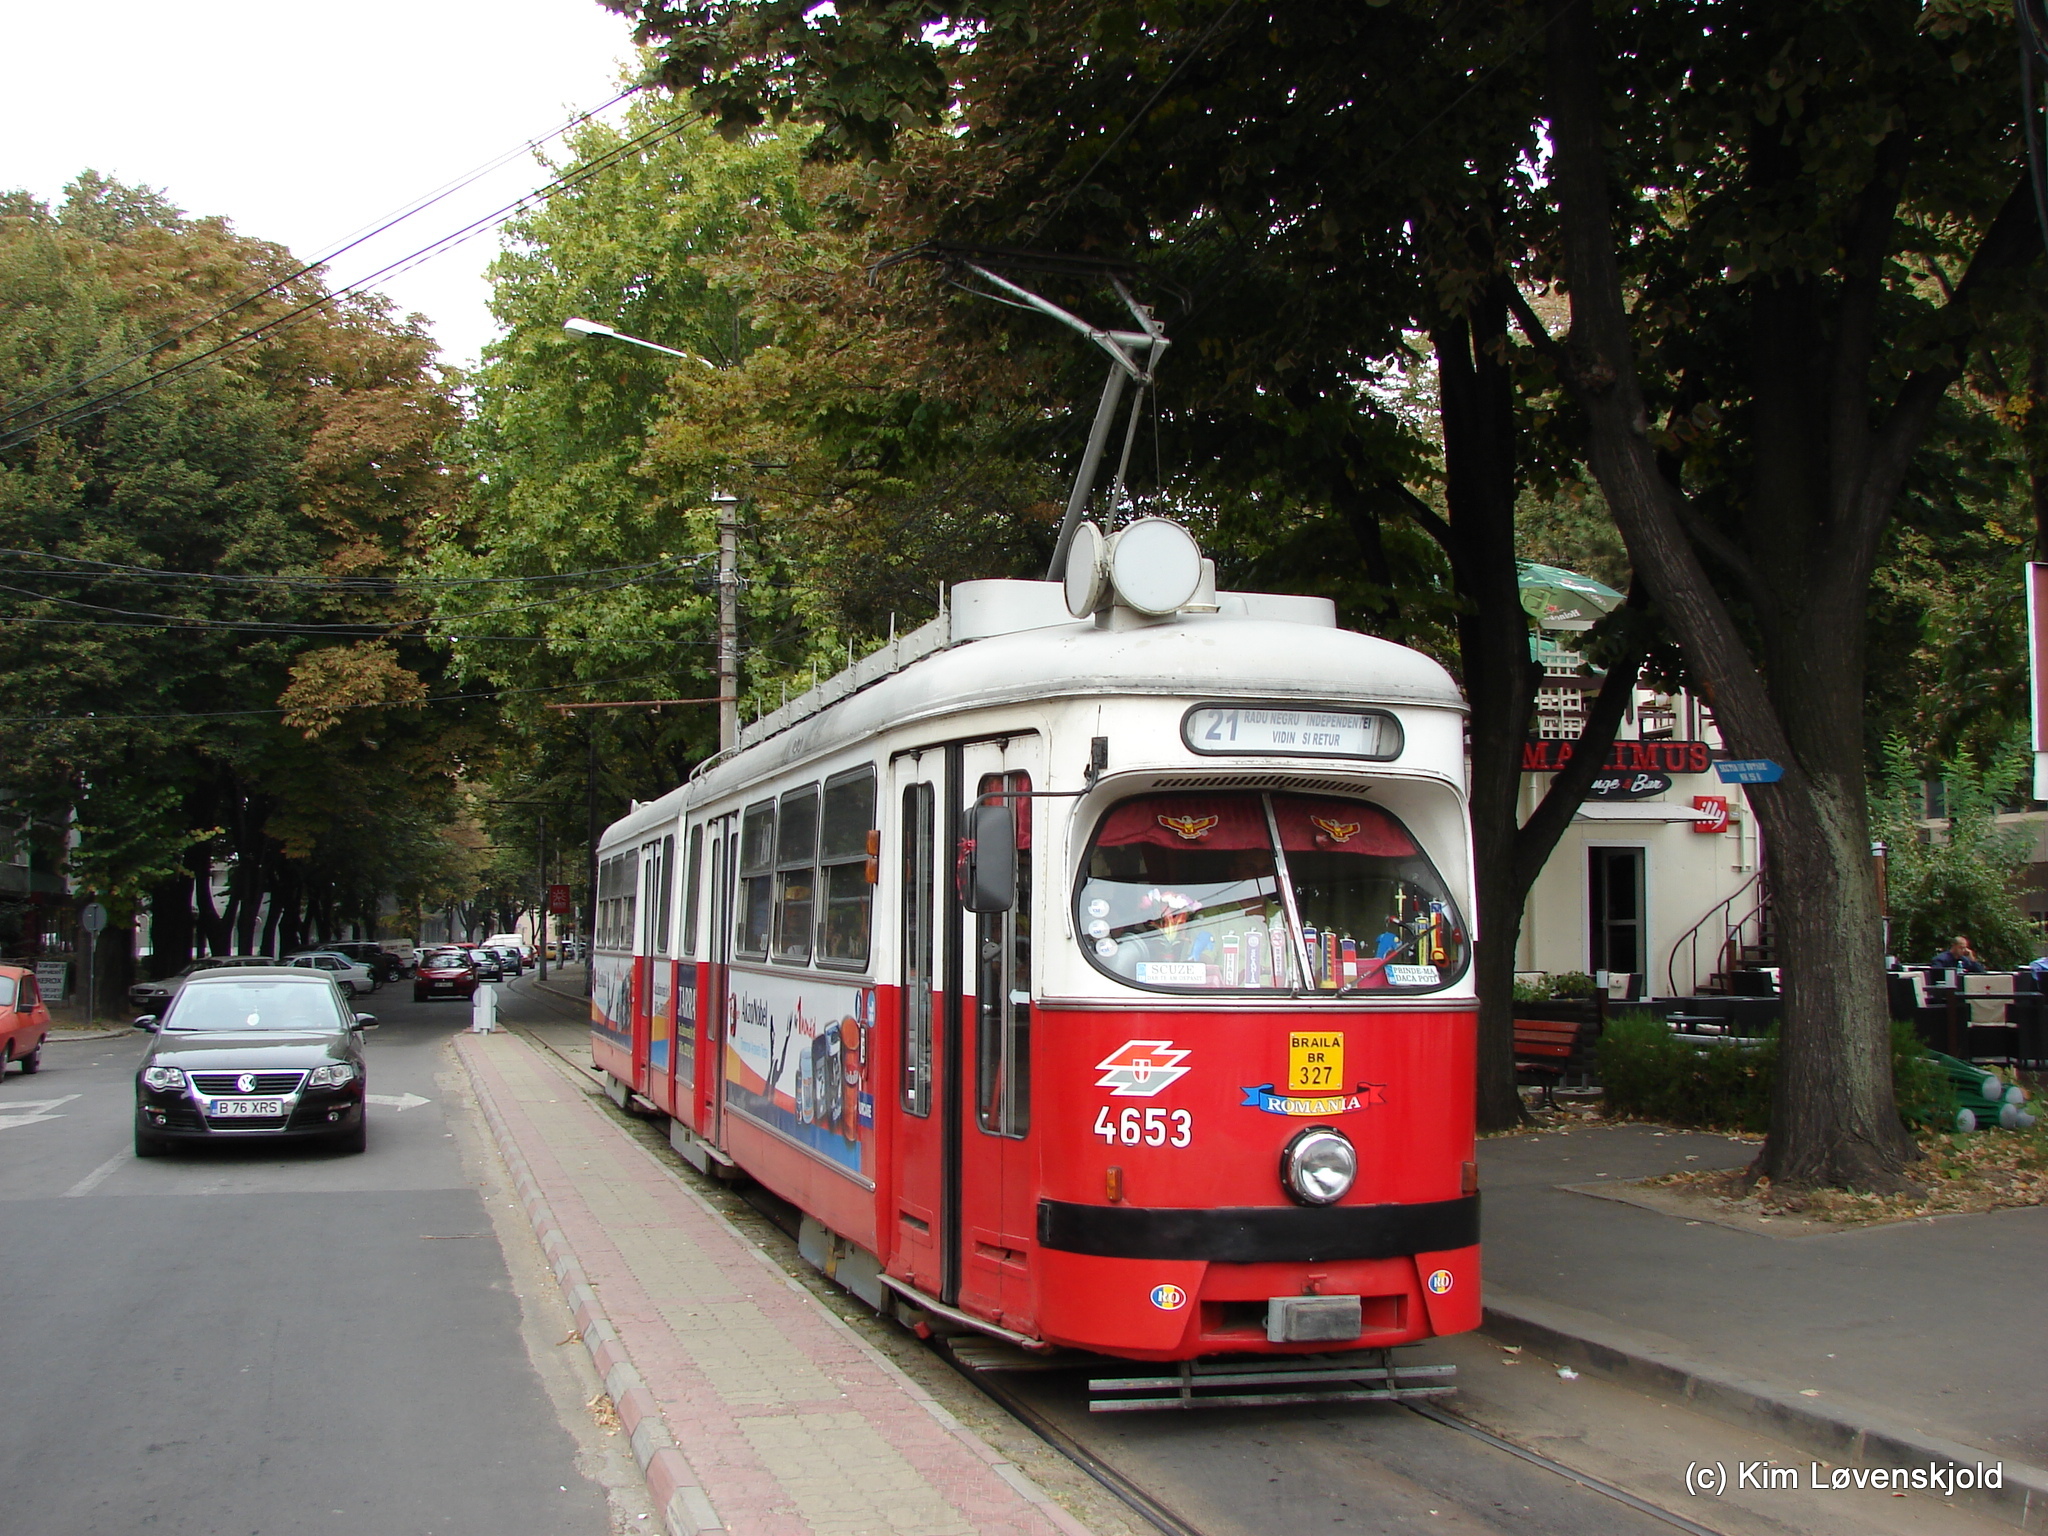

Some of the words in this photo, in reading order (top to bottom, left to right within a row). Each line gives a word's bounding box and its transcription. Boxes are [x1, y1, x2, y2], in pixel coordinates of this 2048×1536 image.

[1205, 709, 1239, 741] 21
[1243, 711, 1268, 725] RADU
[1270, 712, 1300, 726] NEGRU
[1306, 714, 1372, 730] INDEPENDENTEI
[1272, 731, 1295, 744] VIDIN
[1302, 732, 1311, 745] SI
[1312, 732, 1341, 747] RETUR
[1522, 742, 1709, 772] MAIMUS
[1630, 773, 1664, 793] Bar
[1151, 964, 1195, 975] SCUZE
[1291, 1037, 1341, 1048] BRAILA
[1307, 1053, 1325, 1063] BR
[1299, 1066, 1333, 1085] 327
[219, 1101, 229, 1114] B
[232, 1101, 248, 1114] 76
[251, 1101, 278, 1114] XRS
[1267, 1095, 1361, 1113] ROMANIA
[1093, 1105, 1193, 1148] 4653
[1433, 1275, 1449, 1288] RO
[1157, 1290, 1180, 1304] RO
